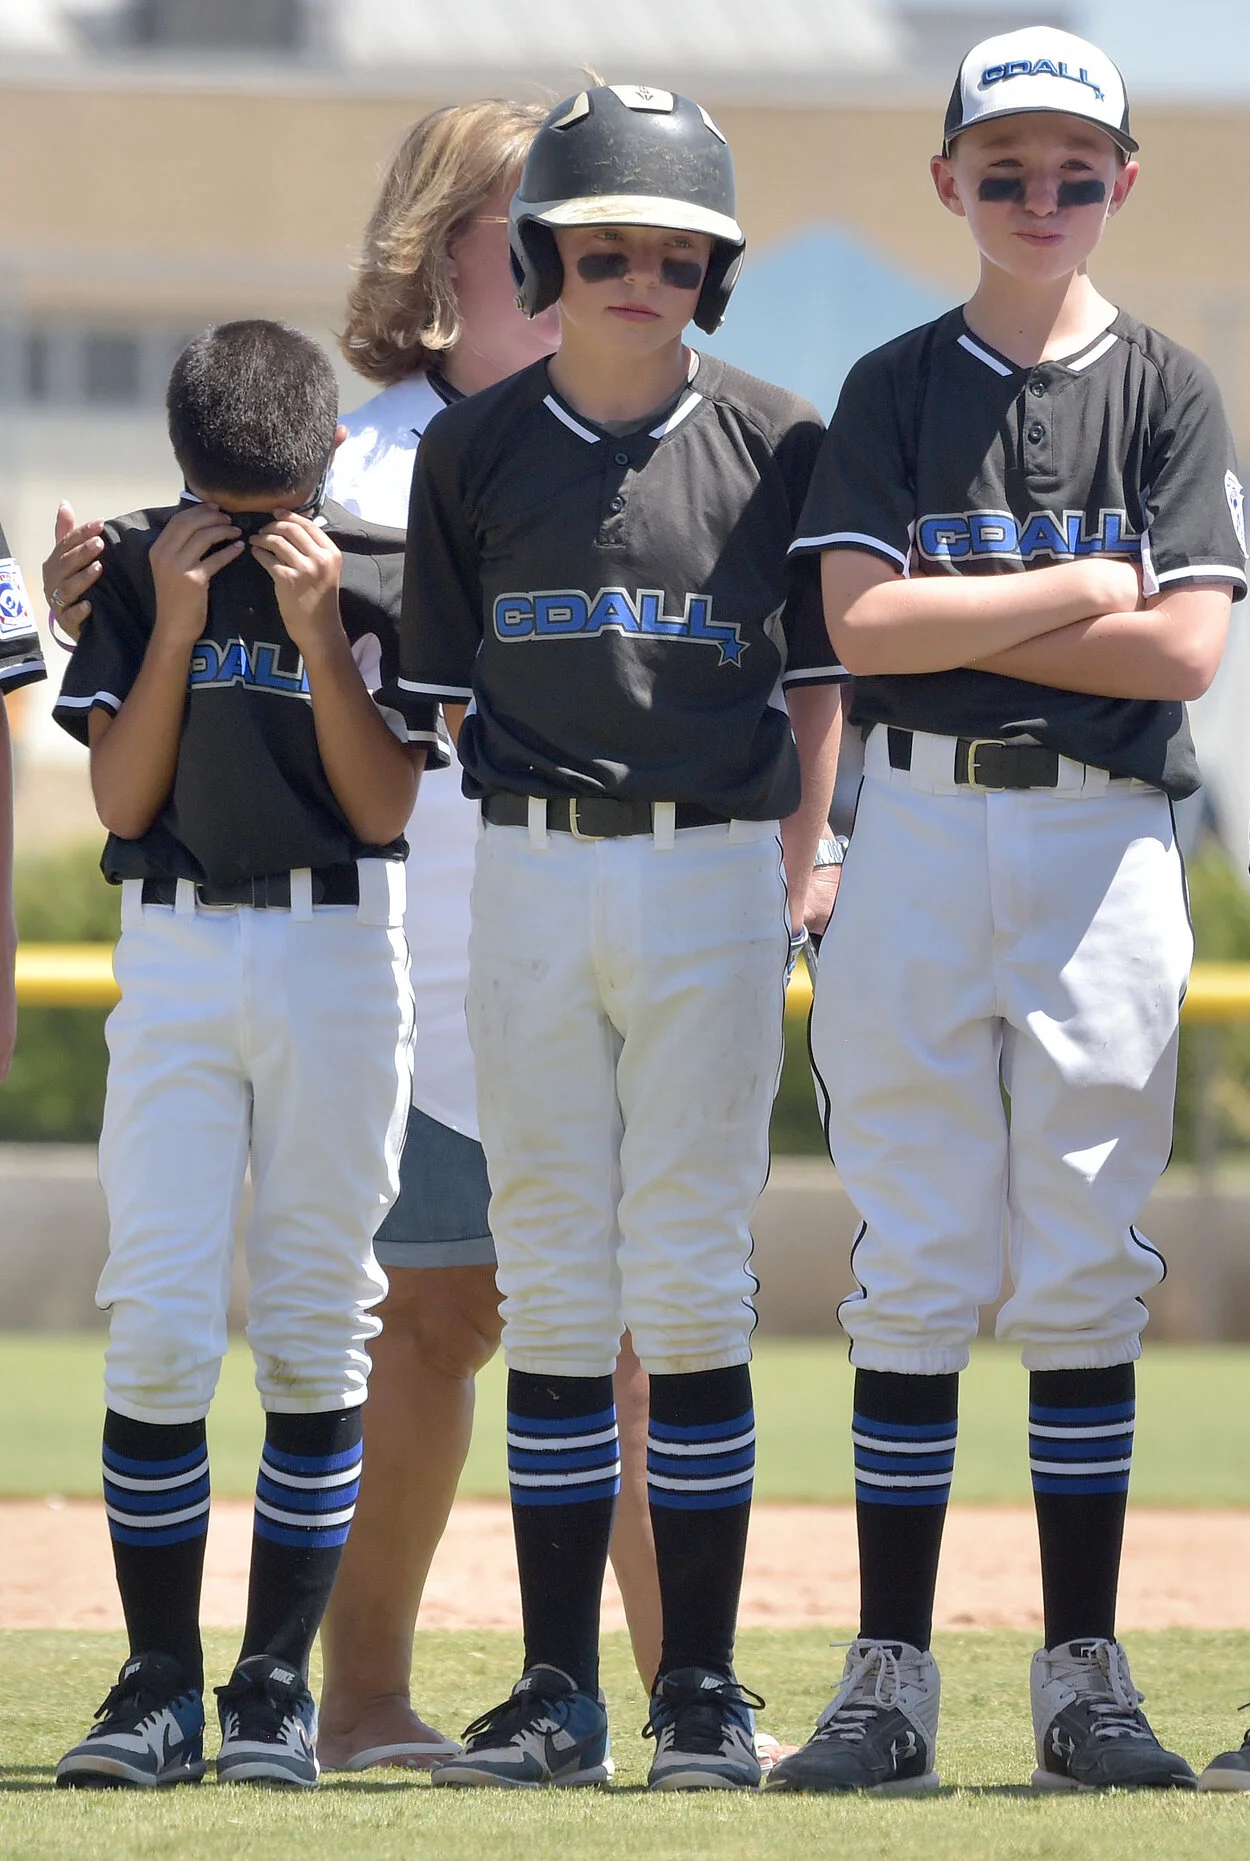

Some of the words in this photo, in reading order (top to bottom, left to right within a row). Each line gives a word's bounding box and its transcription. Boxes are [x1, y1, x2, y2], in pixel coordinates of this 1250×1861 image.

[982, 58, 1100, 90] CDALL
[916, 509, 1142, 561] CDALL
[493, 587, 741, 643] CDALL
[189, 637, 312, 699] DAL
[269, 1667, 295, 1685] NIKE
